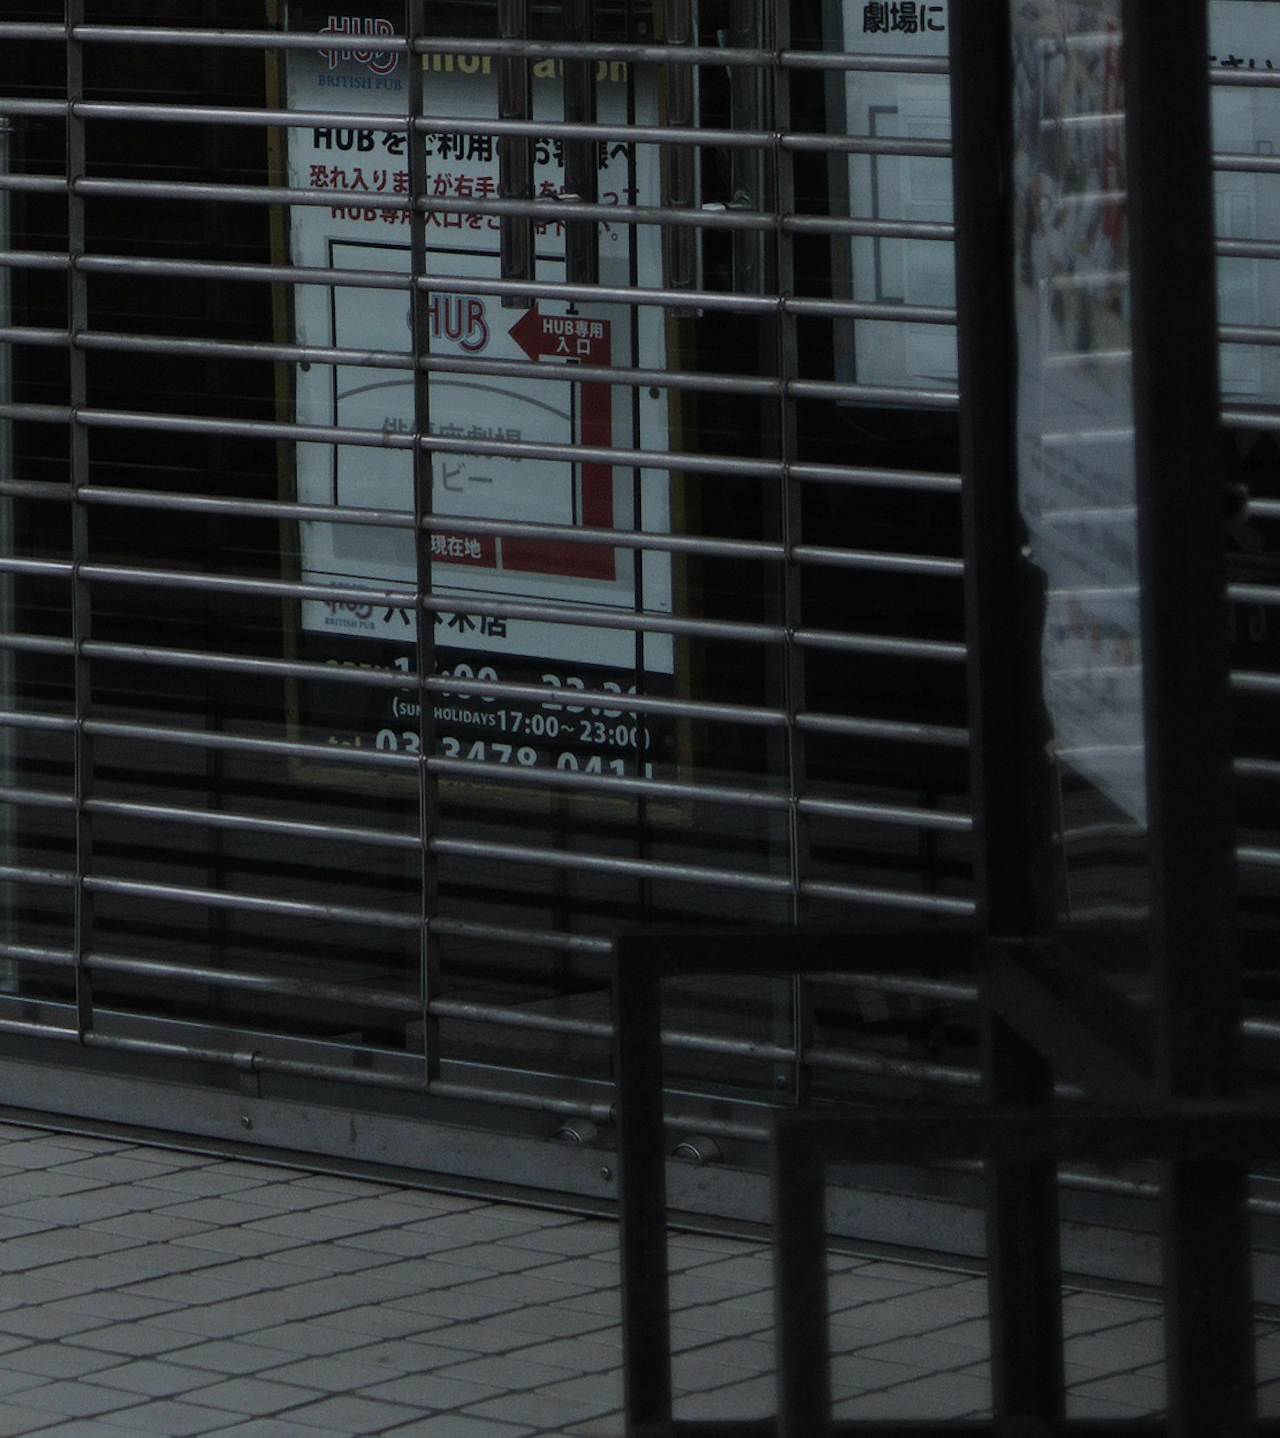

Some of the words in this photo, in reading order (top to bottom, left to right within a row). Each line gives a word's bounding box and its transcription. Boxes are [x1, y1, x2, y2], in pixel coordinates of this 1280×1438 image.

[862, 0, 946, 34] 劇場に
[317, 15, 400, 75] HUB
[318, 74, 372, 89] BRITISH
[375, 77, 402, 91] PUB
[407, 294, 489, 353] HUB
[542, 318, 604, 339] HUB専用
[555, 337, 591, 355] 入口
[430, 536, 482, 560] 現在地
